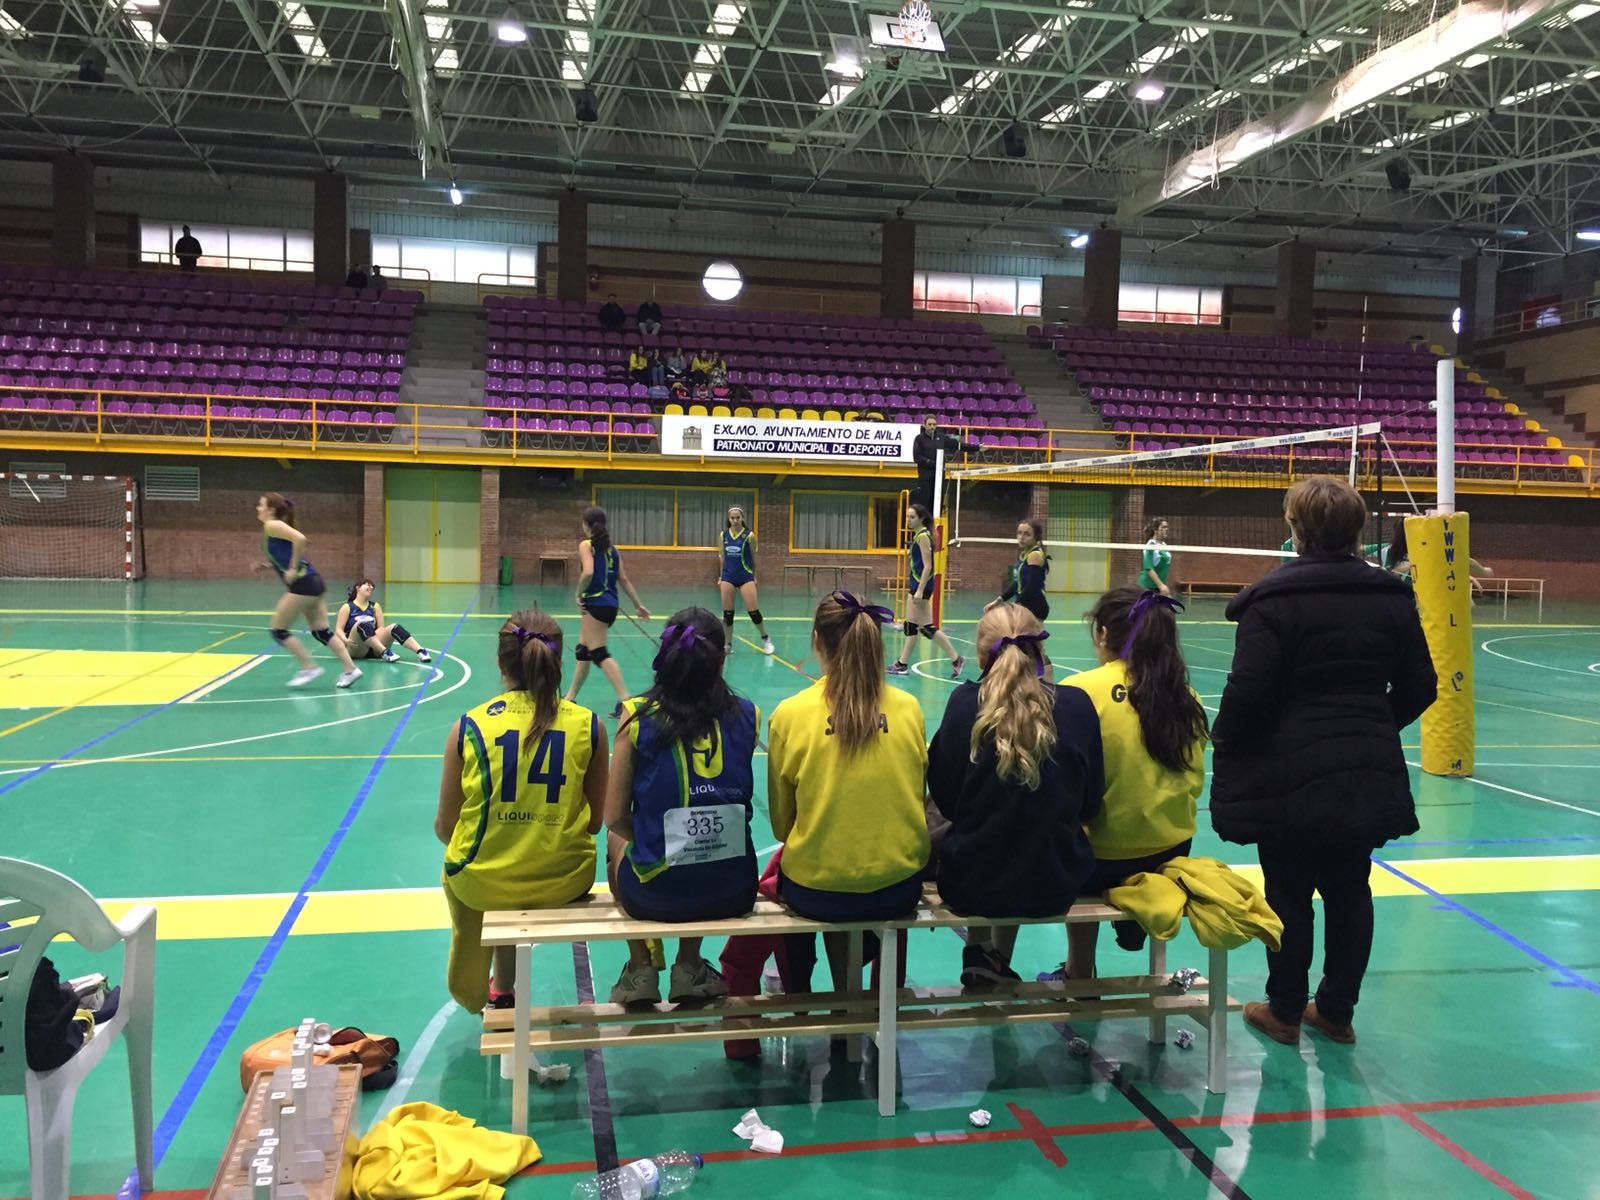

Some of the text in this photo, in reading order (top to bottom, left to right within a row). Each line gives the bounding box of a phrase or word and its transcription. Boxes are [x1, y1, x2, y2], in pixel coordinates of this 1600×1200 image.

[713, 424, 902, 442] EXCMO. AYUNTAMIENTO DE AVILA
[716, 440, 899, 456] PATRONATO MUNICIPAL DE DEPORTES
[495, 729, 567, 804] 14
[687, 816, 724, 836] 335
